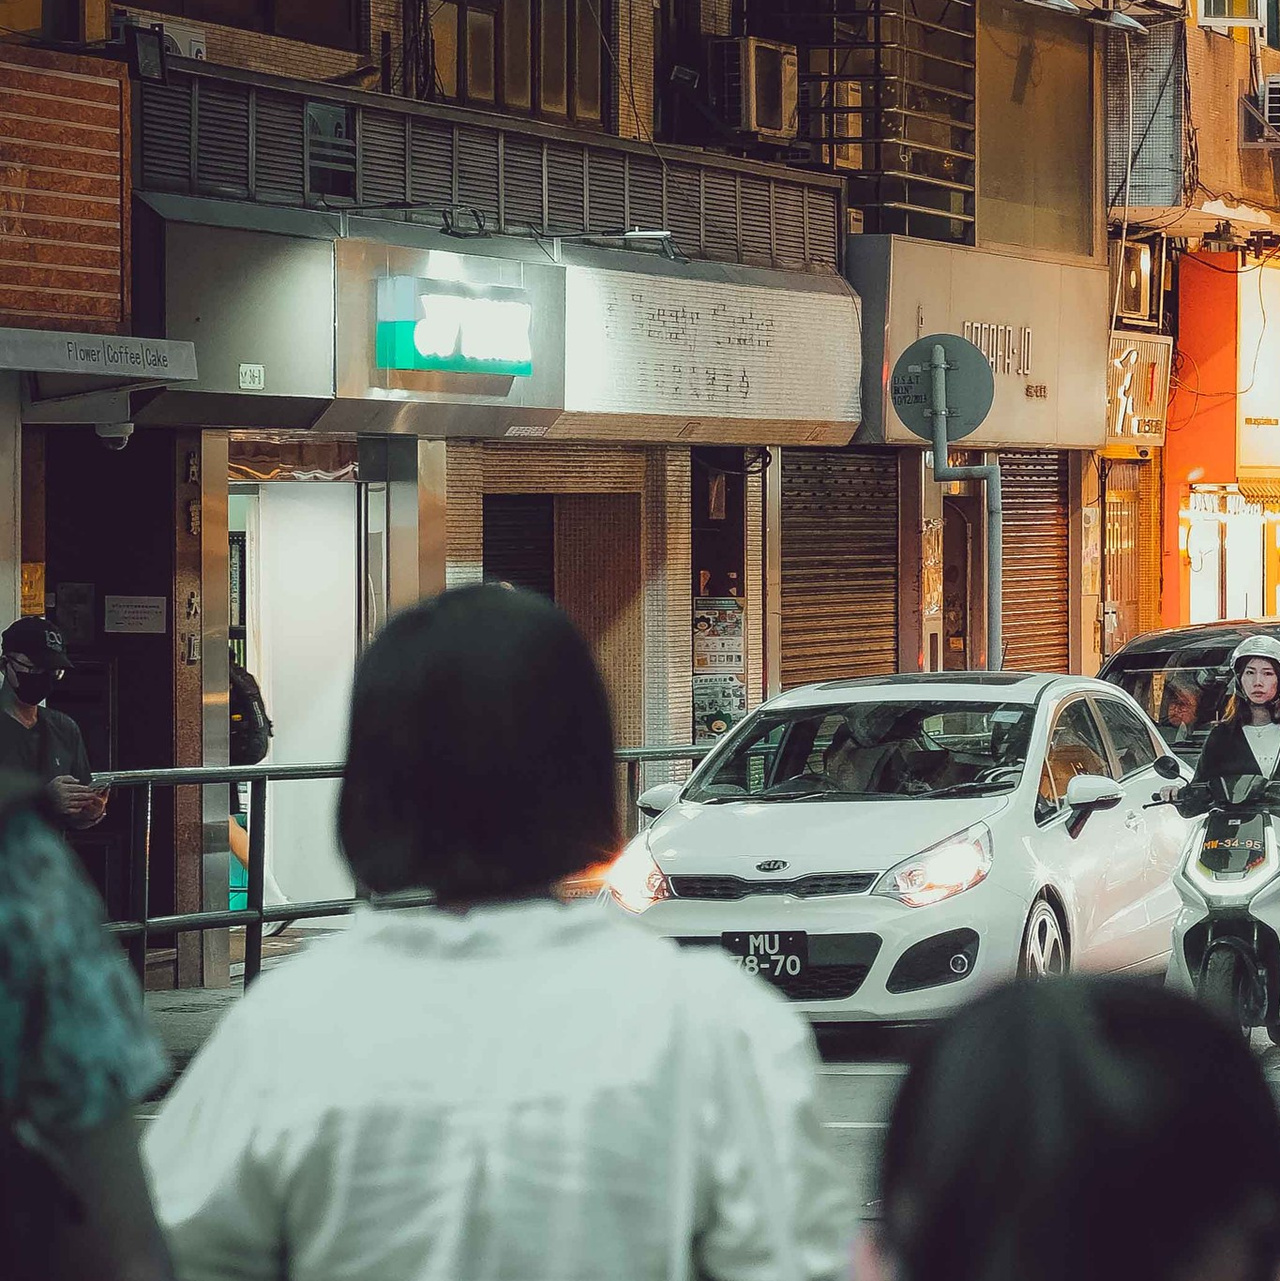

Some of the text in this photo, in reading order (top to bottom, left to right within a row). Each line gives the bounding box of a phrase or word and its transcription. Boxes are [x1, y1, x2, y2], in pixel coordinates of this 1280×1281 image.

[761, 860, 784, 869] KIA
[748, 934, 780, 955] MU
[729, 954, 801, 976] 78-70
